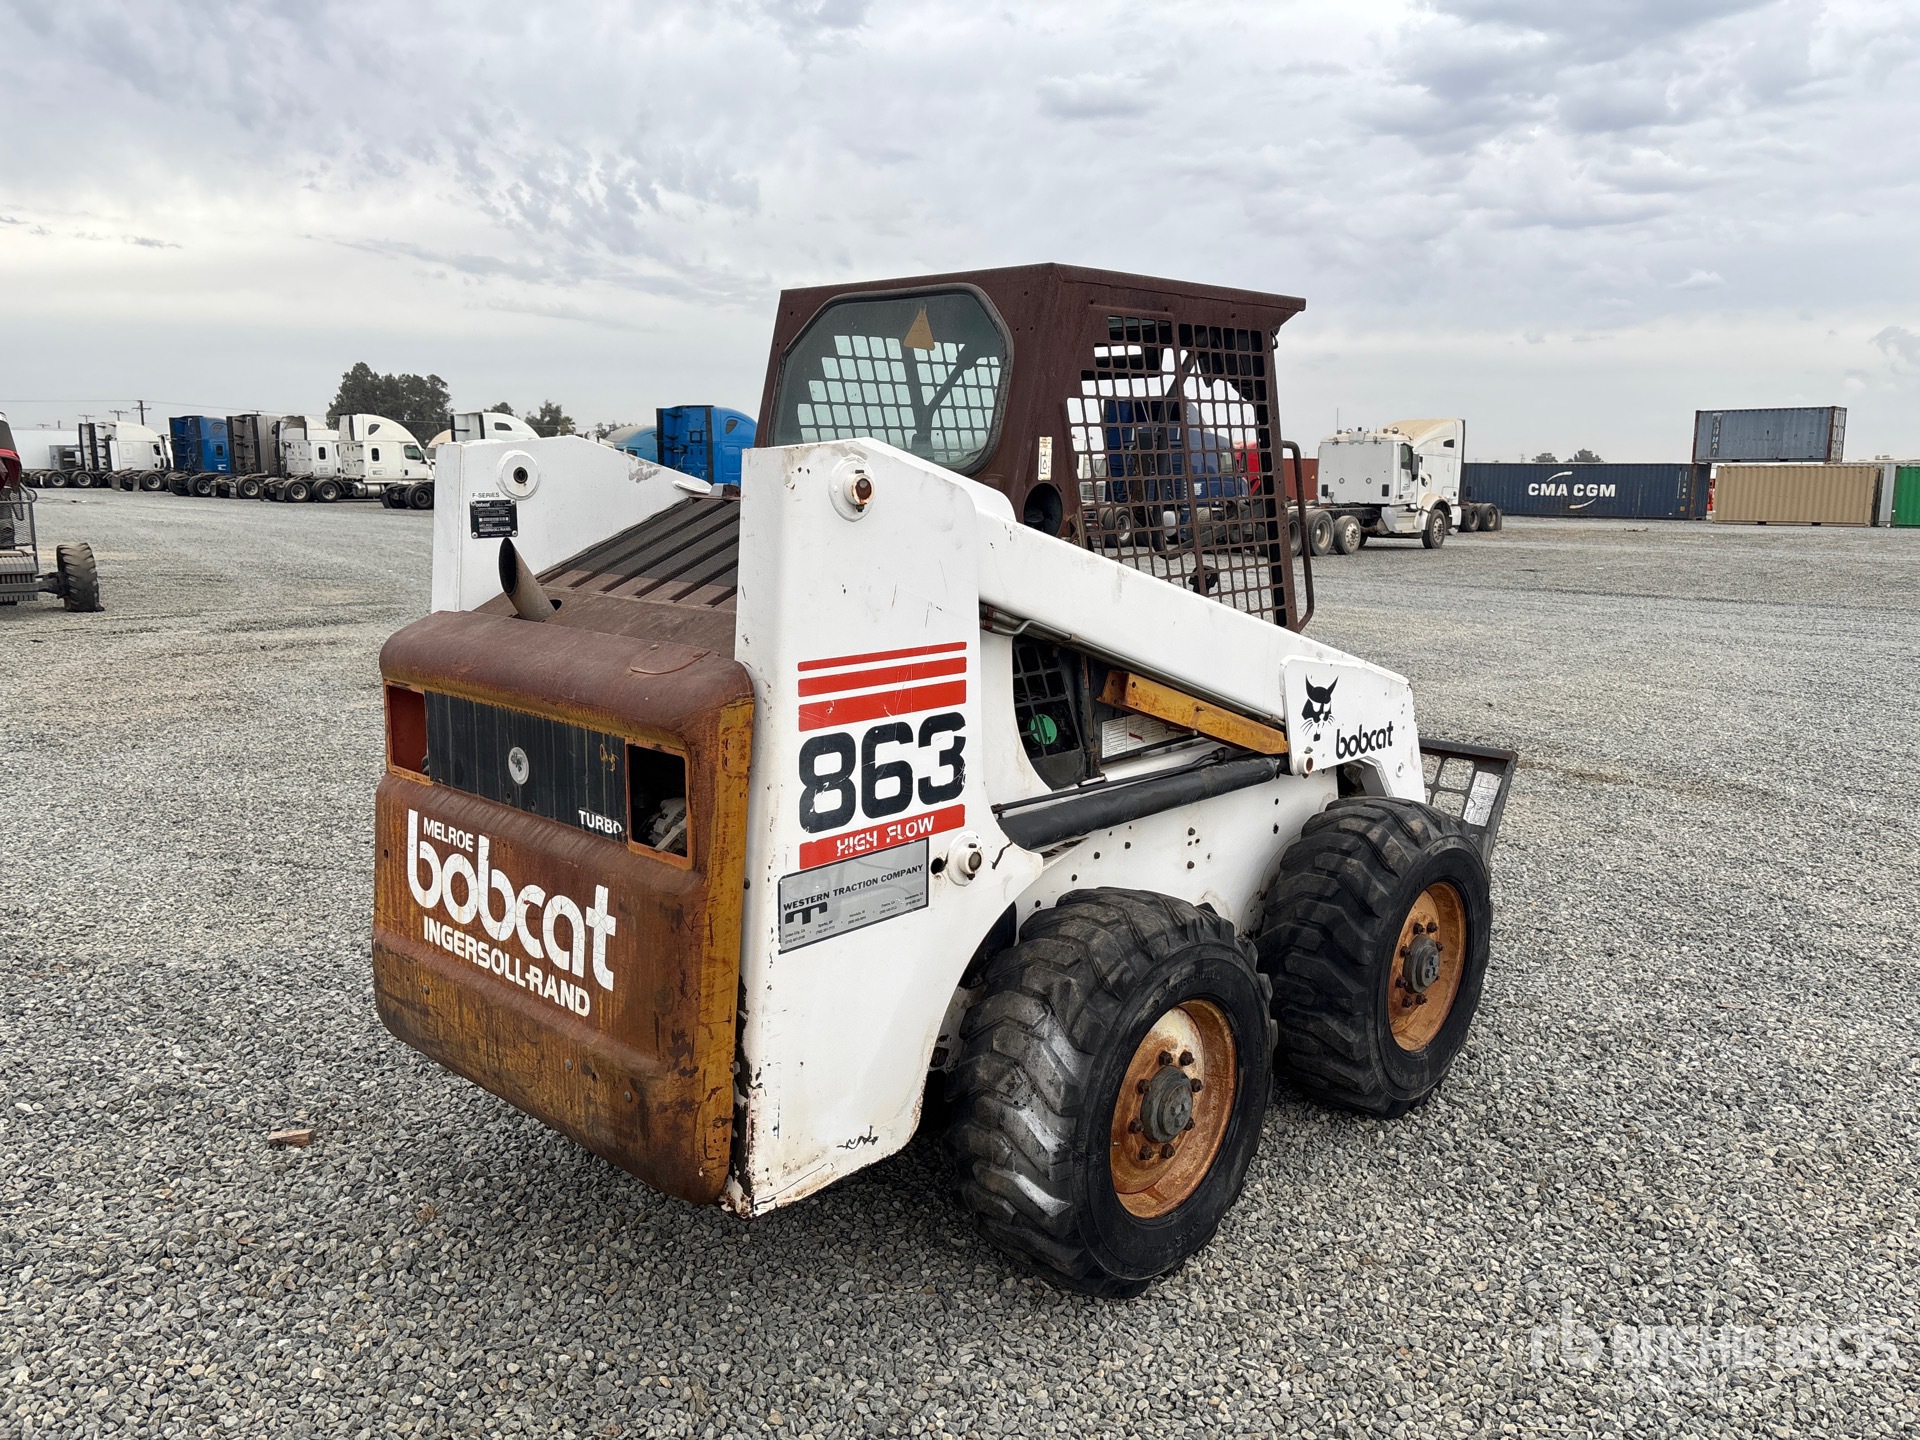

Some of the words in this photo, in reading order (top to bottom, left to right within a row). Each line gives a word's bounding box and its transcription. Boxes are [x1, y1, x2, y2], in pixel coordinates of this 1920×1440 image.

[1528, 483, 1568, 496] CMA
[1573, 484, 1616, 497] CGM
[1336, 721, 1394, 759] bobcat
[799, 711, 967, 834] 863
[423, 817, 474, 853] MELROE
[578, 809, 623, 834] TURBO
[836, 831, 878, 857] HIGH
[886, 816, 935, 843] FLOW
[407, 808, 617, 992] bobcat
[783, 891, 830, 911] WESTERN
[833, 877, 879, 897] TRACTION
[880, 864, 924, 883] COMPANY
[423, 916, 591, 1017] INGERSOLL-RAND
